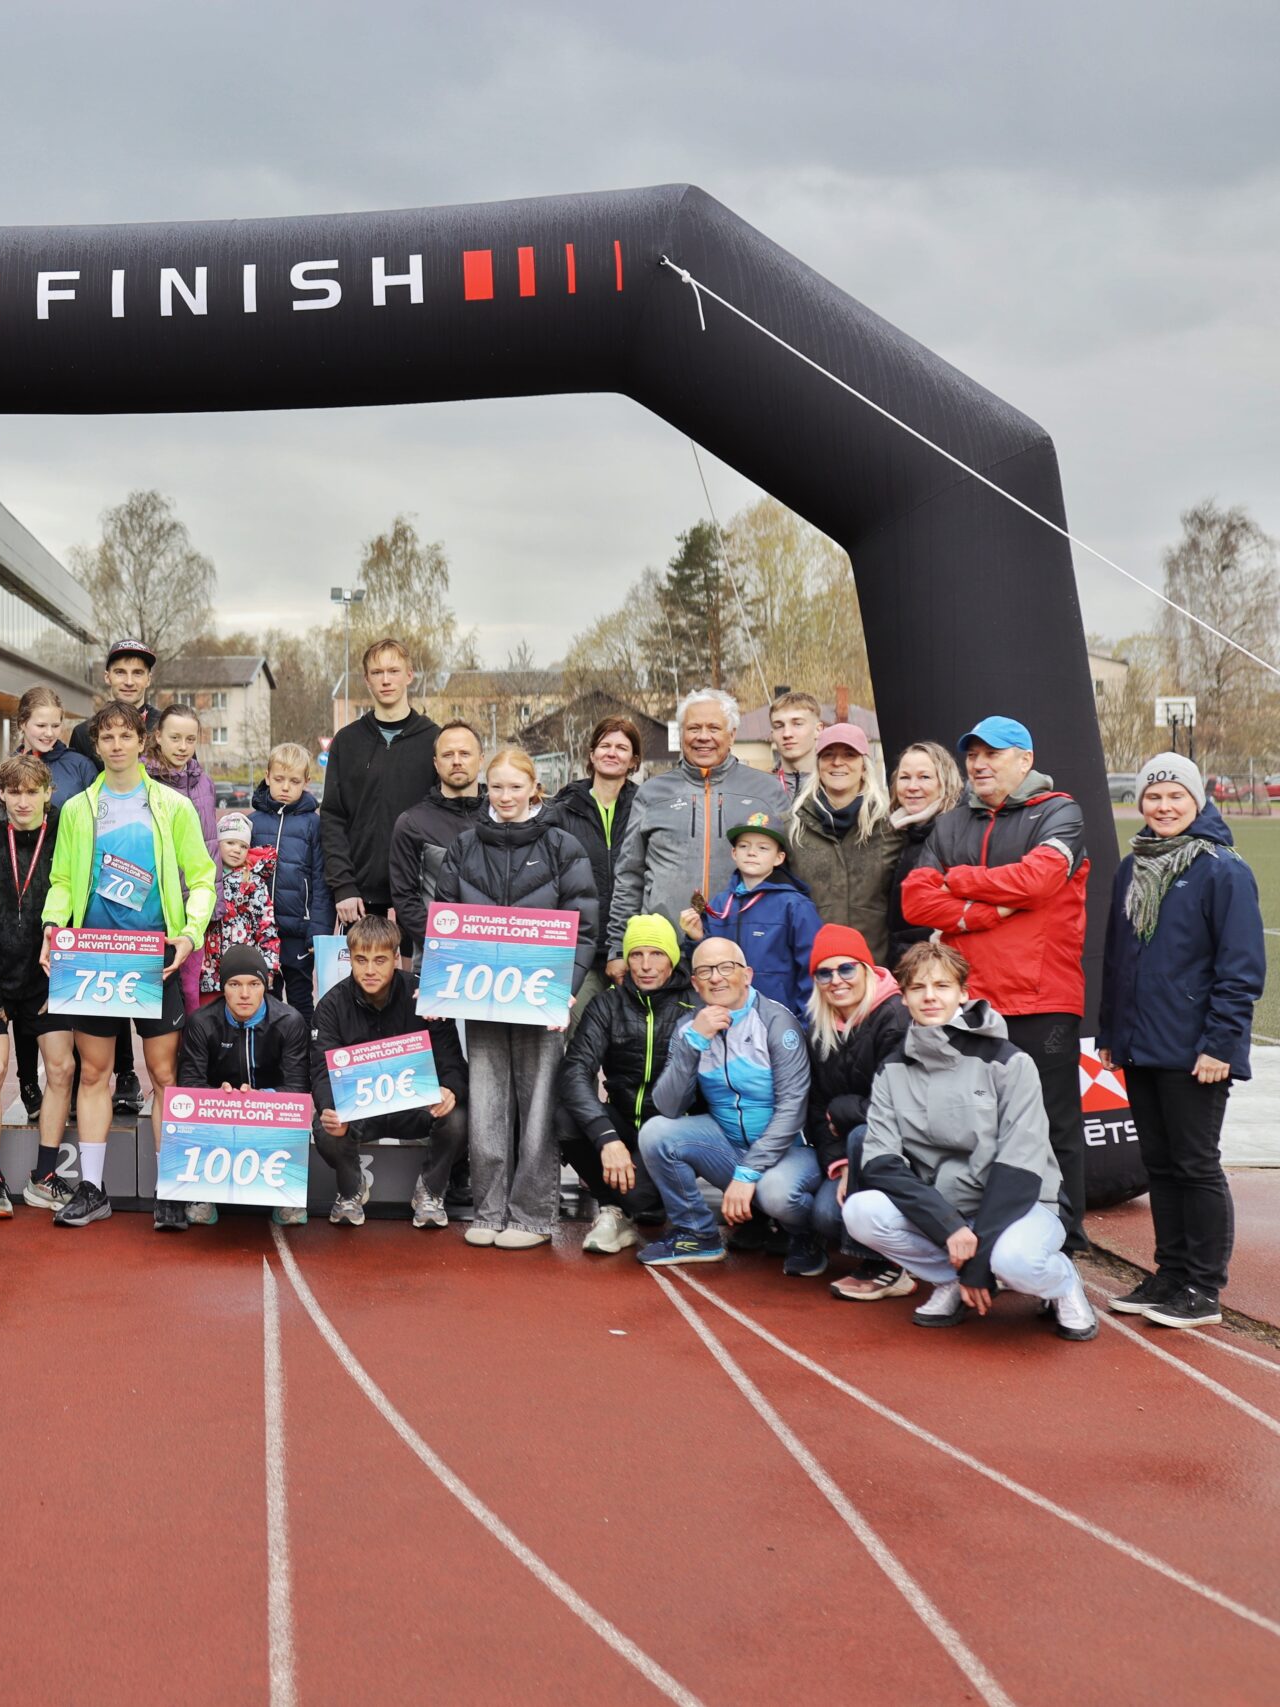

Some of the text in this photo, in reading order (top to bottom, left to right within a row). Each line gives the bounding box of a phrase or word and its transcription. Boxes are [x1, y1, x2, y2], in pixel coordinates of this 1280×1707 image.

[36, 253, 424, 321] FINISH
[104, 874, 135, 900] 70
[463, 914, 572, 929] LATVIJAS ČEMPIONĀTS
[78, 933, 160, 943] LATVIJAS ČEMPIONĀTS
[462, 923, 540, 938] AKVATLONĀ
[77, 940, 137, 951] AKVATLONĀ
[74, 969, 142, 1004] 75€
[436, 963, 555, 1006] 100€
[351, 1044, 381, 1055] LATVIJAS
[352, 1046, 405, 1063] AKVATLONĀ
[355, 1068, 416, 1107] 50€
[198, 1098, 305, 1112] LATVIJAS ČEMPIONĀTS
[197, 1109, 274, 1121] AKVATLONĀ
[55, 1142, 79, 1178] 2
[176, 1146, 292, 1188] 100€
